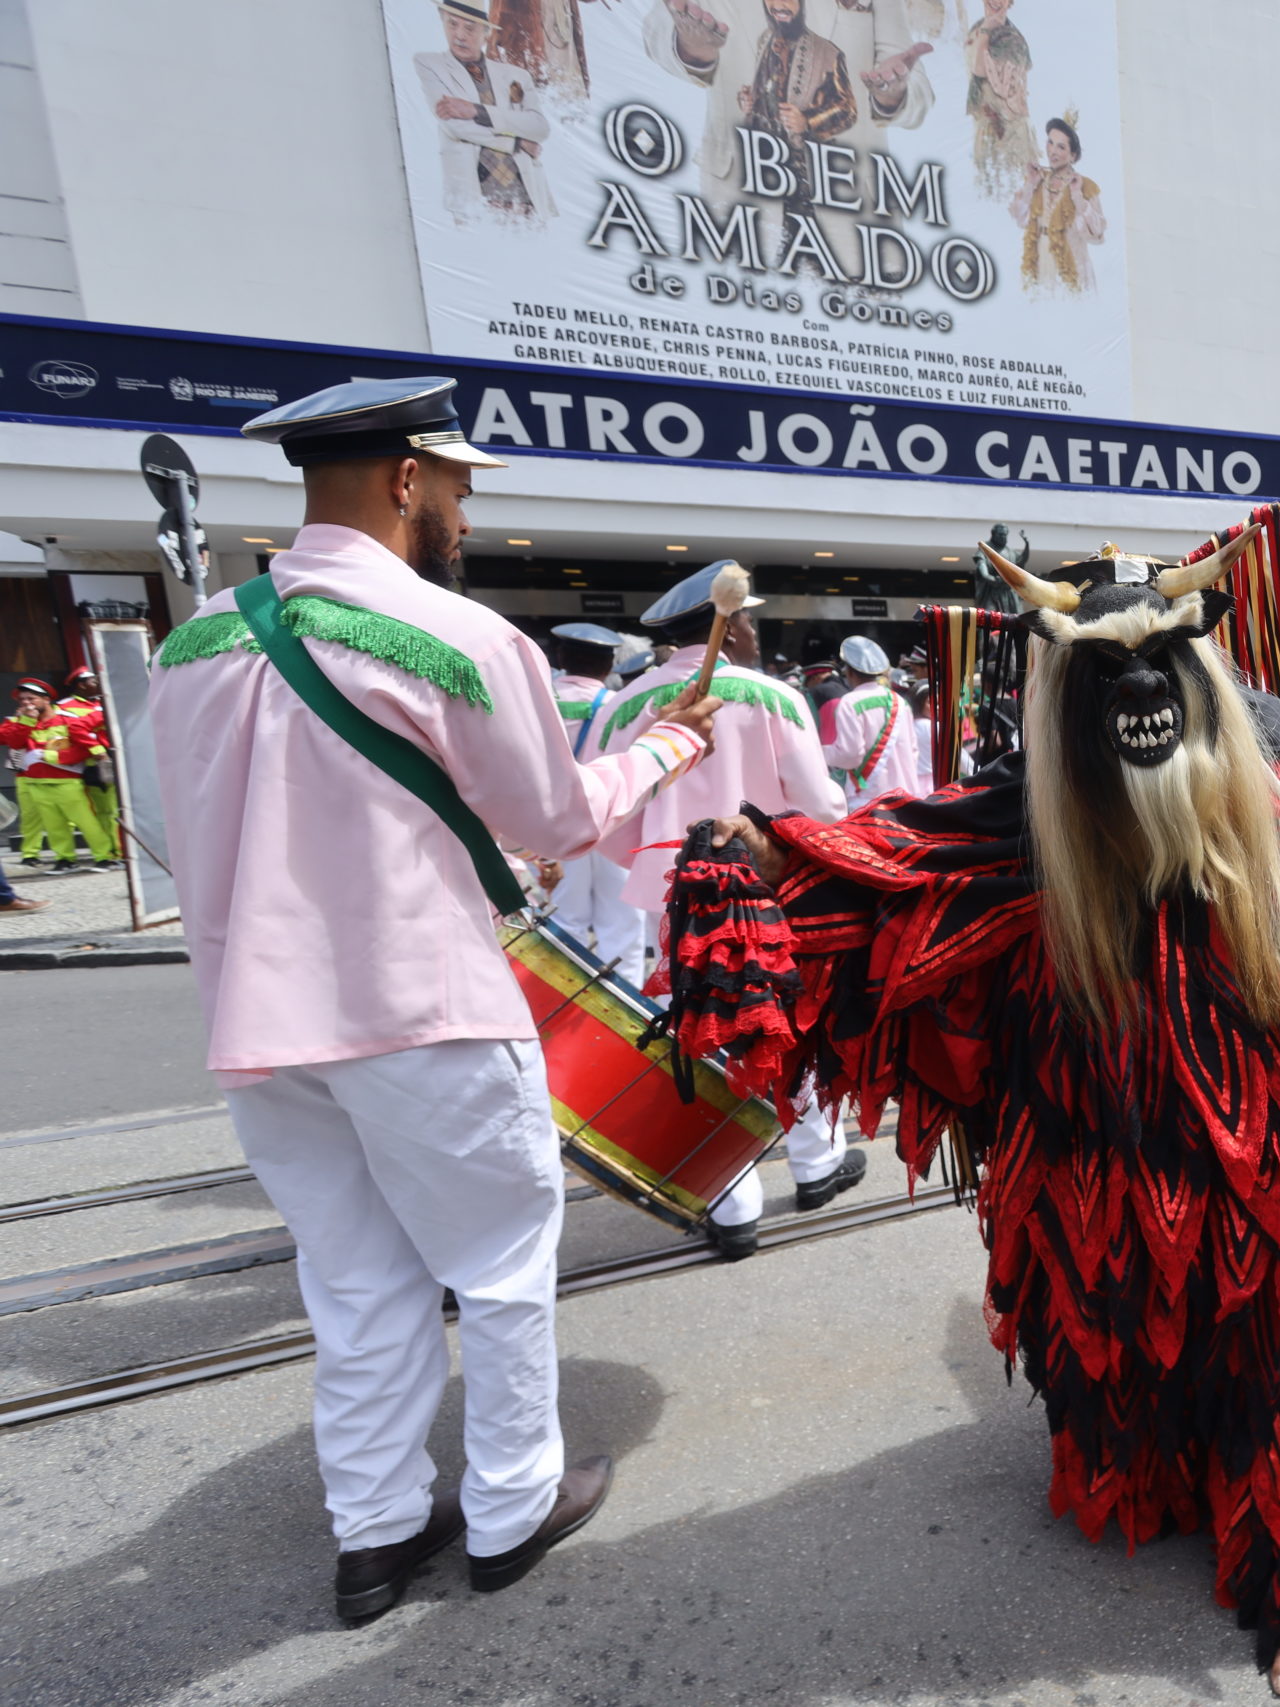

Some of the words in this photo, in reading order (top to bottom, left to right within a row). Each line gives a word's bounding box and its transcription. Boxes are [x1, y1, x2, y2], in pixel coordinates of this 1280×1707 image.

[605, 103, 683, 176] O
[736, 126, 949, 226] BEM
[587, 181, 996, 301] AMADO
[630, 264, 684, 297] de
[709, 276, 801, 312] Dias
[822, 293, 953, 331] Gomes
[803, 319, 830, 332] Com
[488, 320, 548, 340] ATAÍDE
[554, 328, 657, 352] ARCOVERDE,
[663, 340, 710, 357] CHRIS
[716, 347, 772, 366] PENNA,
[777, 353, 822, 369] LUCAS
[828, 359, 913, 380] FIGUEIREDO,
[918, 368, 964, 385] MARCO
[1044, 382, 1087, 398] NEGÃO,
[513, 302, 567, 321] TADEU
[574, 310, 634, 331] MELLO,
[640, 317, 699, 336] RENATA
[706, 325, 764, 344] CASTRO
[771, 332, 843, 355] BARBOSA,
[848, 342, 909, 361] PATRÍCIA
[915, 350, 958, 367] PINHO,
[963, 355, 995, 370] ROSE
[1000, 360, 1067, 379] ABDALLAH,
[514, 344, 586, 364] GABRIEL
[592, 352, 714, 379] ALBUQUERQUE,
[719, 366, 770, 385] ROLLO,
[776, 372, 842, 391] EZEQUIEL
[847, 378, 943, 400] VASCONCELOS
[947, 389, 954, 400] E
[959, 390, 987, 405] LUIZ
[992, 394, 1072, 412] FURLANETTO.
[195, 388, 215, 397] RIO
[216, 389, 232, 398] DE
[234, 391, 278, 402] JANEIRO
[737, 403, 948, 475] JOÃO
[975, 429, 1262, 495] CAETANO
